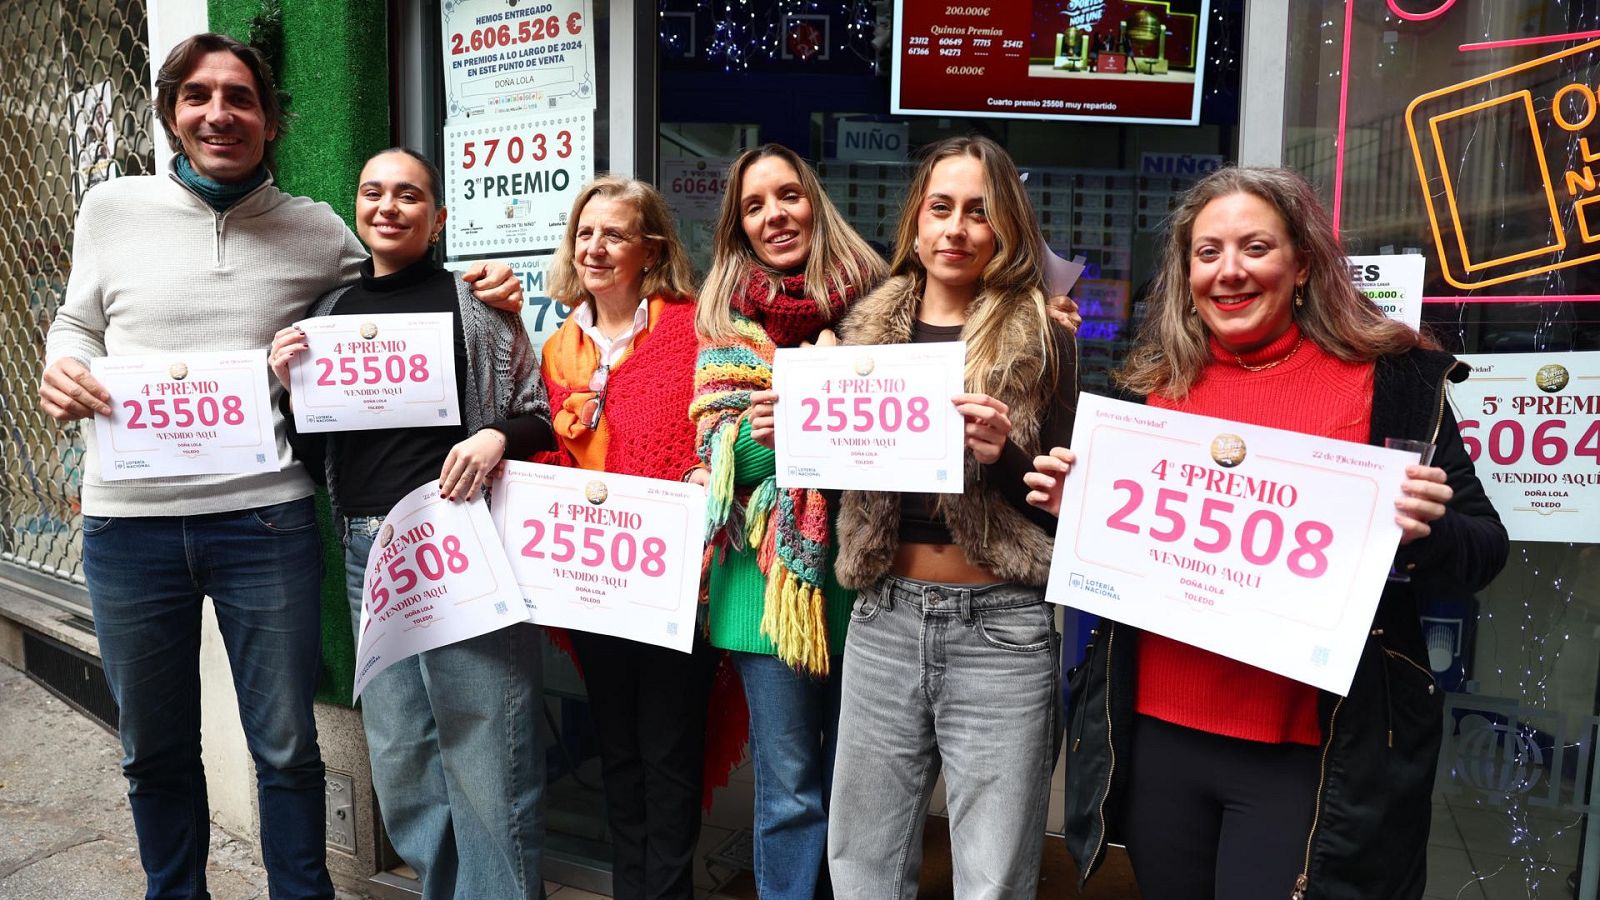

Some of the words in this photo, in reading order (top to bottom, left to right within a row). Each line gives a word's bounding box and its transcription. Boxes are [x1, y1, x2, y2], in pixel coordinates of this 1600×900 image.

[476, 13, 502, 25] HEMOS
[505, 4, 552, 20] ENTREGADO
[452, 16, 560, 55] 2.606.526
[567, 12, 582, 34] €
[930, 25, 966, 36] Quintos
[967, 26, 1003, 36] Premios
[939, 38, 962, 46] 60649
[452, 61, 462, 69] EN
[464, 54, 498, 67] PREMIOS
[507, 51, 516, 60] LO
[520, 47, 545, 58] LARGO
[561, 41, 582, 51] 2024
[480, 65, 496, 74] ESTE
[498, 61, 524, 72] PUNTO
[526, 59, 536, 68] DE
[538, 54, 564, 66] VENTA
[495, 78, 514, 88] DOÑA
[516, 76, 534, 85] LOLA
[988, 98, 1012, 106] Cuarto
[1042, 100, 1064, 108] 25508
[1065, 102, 1082, 110] muy
[1083, 102, 1117, 110] repartido
[845, 128, 900, 150] NIÑO
[462, 130, 572, 170] 57033
[484, 168, 570, 198] PREMIO
[348, 340, 406, 354] PREMIO
[316, 354, 430, 386] 25508
[157, 381, 218, 395] PREMIO
[838, 378, 906, 394] PREMIO
[123, 396, 244, 430] 25508
[801, 396, 930, 432] 25508
[830, 438, 870, 446] VENDIDO
[1336, 454, 1384, 470] Diciembre
[1180, 463, 1298, 508] PREMIO
[1492, 472, 1558, 484] VENDIDO
[568, 504, 642, 530] PREMIO
[1106, 479, 1334, 578] 25508
[375, 522, 435, 574] PREMIO
[521, 518, 666, 578] 25508
[1150, 548, 1216, 576] VENDIDO
[553, 568, 598, 582] VENDIDO
[1086, 578, 1114, 592] LOTERÍA
[363, 535, 470, 636] 5508
[1084, 586, 1120, 600] NACIONAL
[1180, 578, 1202, 589] DOÑA
[1204, 584, 1224, 595] LOLA
[378, 594, 422, 622] VENDIDO
[1184, 592, 1214, 606] TOLEDO
[404, 610, 420, 618] DOÑA
[412, 614, 433, 624] TOLEDO
